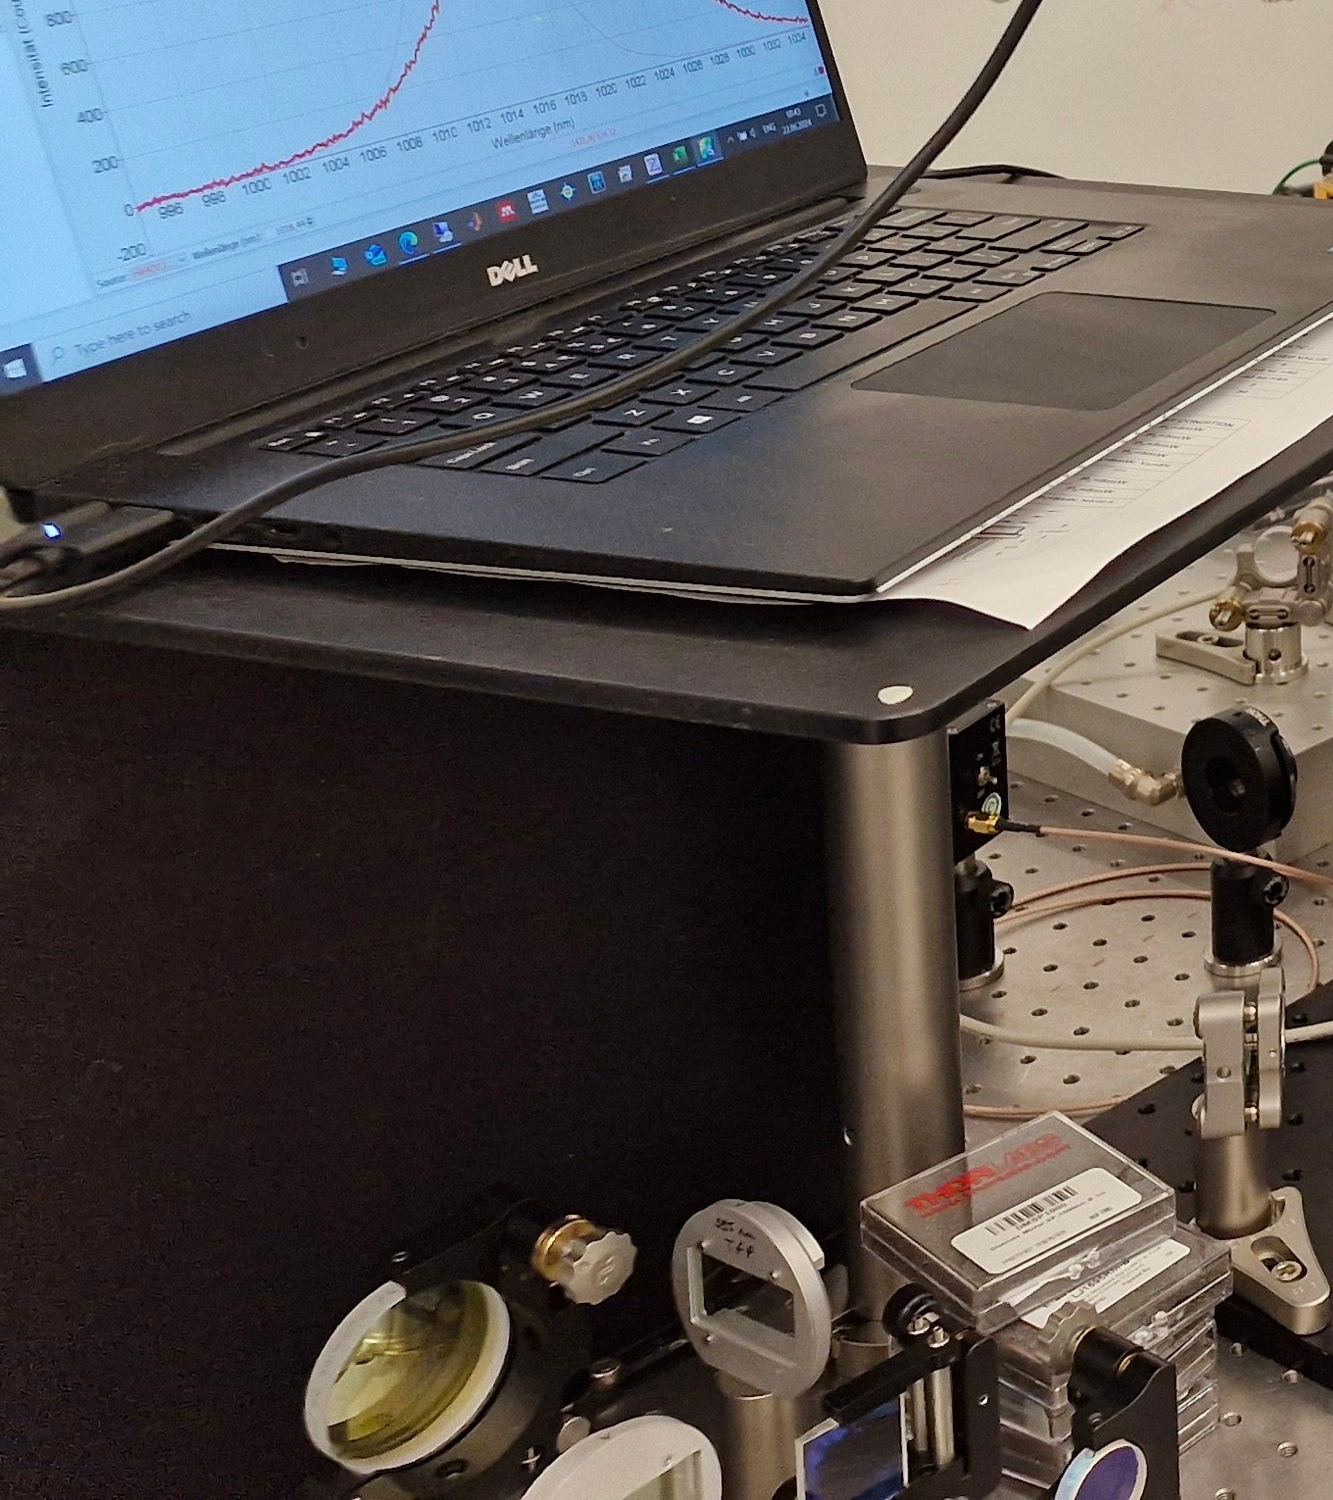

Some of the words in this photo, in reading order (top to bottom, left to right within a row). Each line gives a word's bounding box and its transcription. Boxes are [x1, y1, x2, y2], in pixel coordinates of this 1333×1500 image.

[77, 107, 103, 125] 400
[552, 116, 576, 134] (nm)
[92, 155, 118, 174] 200
[123, 202, 134, 218] 0
[116, 241, 147, 264] -200
[486, 254, 539, 288] DELL
[73, 337, 105, 358] Type
[107, 326, 136, 346] here
[136, 322, 152, 337] to
[153, 310, 192, 332] search
